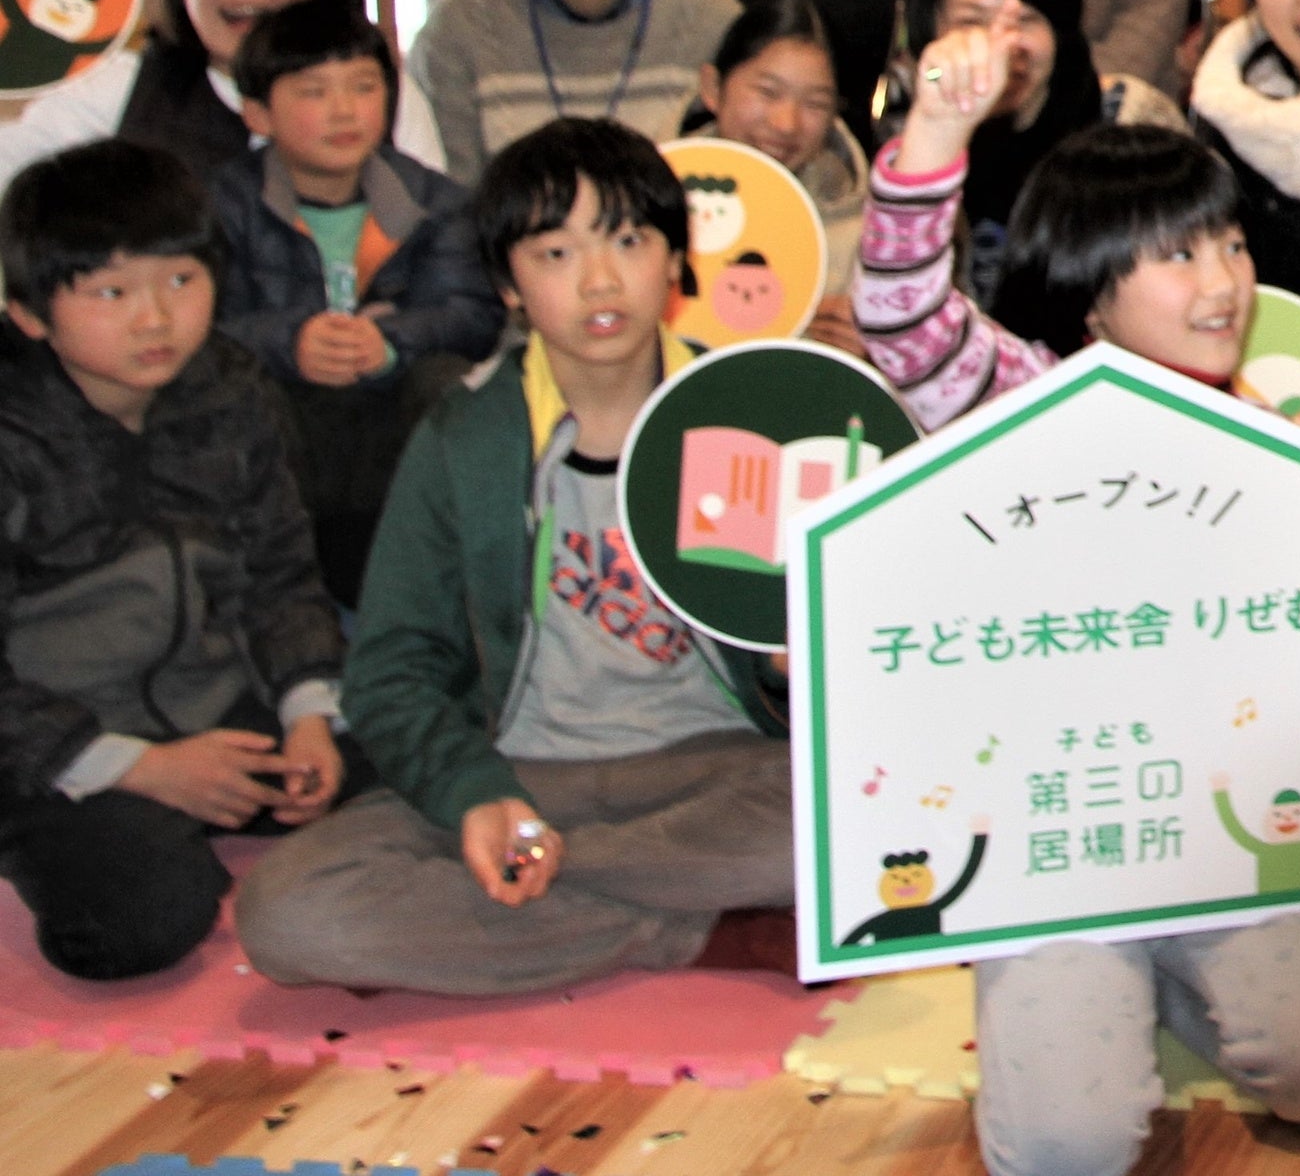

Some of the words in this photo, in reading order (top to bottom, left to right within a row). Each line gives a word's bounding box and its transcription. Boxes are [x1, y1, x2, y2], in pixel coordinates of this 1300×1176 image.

[869, 602, 1172, 673] 子ども未来舎
[1056, 722, 1153, 752] 子ども
[1024, 759, 1183, 815] 第三の
[1024, 815, 1184, 875] 居場所
